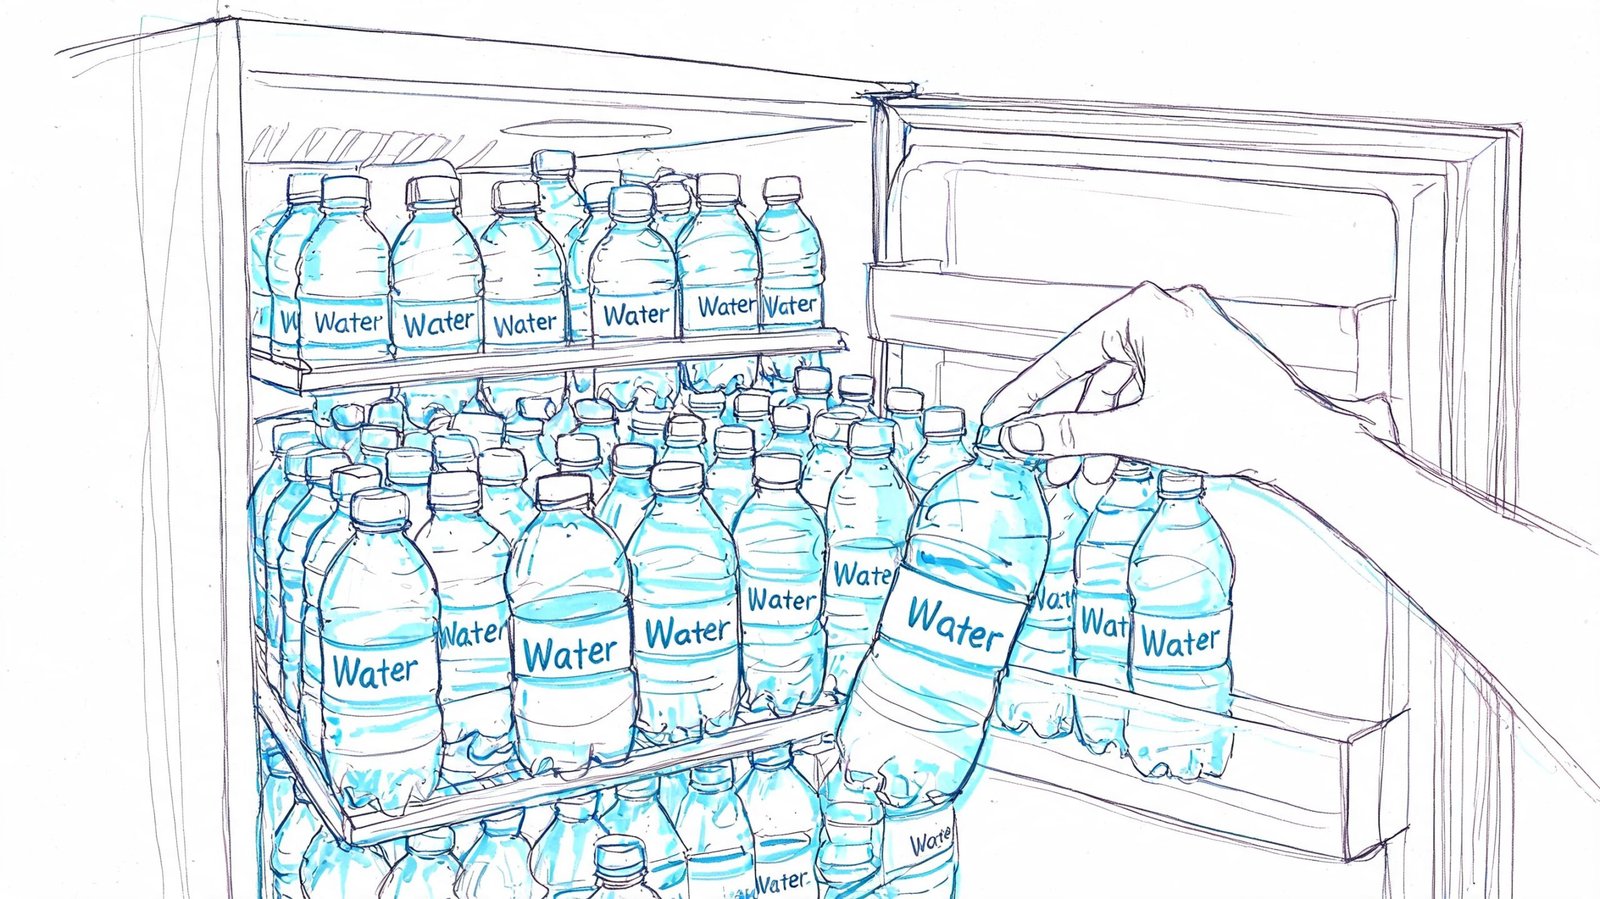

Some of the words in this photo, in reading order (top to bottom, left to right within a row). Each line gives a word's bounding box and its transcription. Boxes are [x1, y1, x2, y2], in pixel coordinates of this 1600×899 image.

[603, 303, 671, 327] Water
[698, 295, 757, 317] Water
[315, 309, 383, 333] Water
[403, 311, 475, 338] Water
[493, 312, 557, 338] Water
[833, 560, 892, 587] Wate
[748, 587, 818, 611] Water
[438, 620, 508, 650] Water
[645, 616, 731, 650] Water
[907, 595, 1004, 652] Water
[1081, 605, 1129, 638] Wat
[523, 637, 618, 673] Water
[1141, 624, 1221, 658] Water
[332, 654, 419, 690] Water
